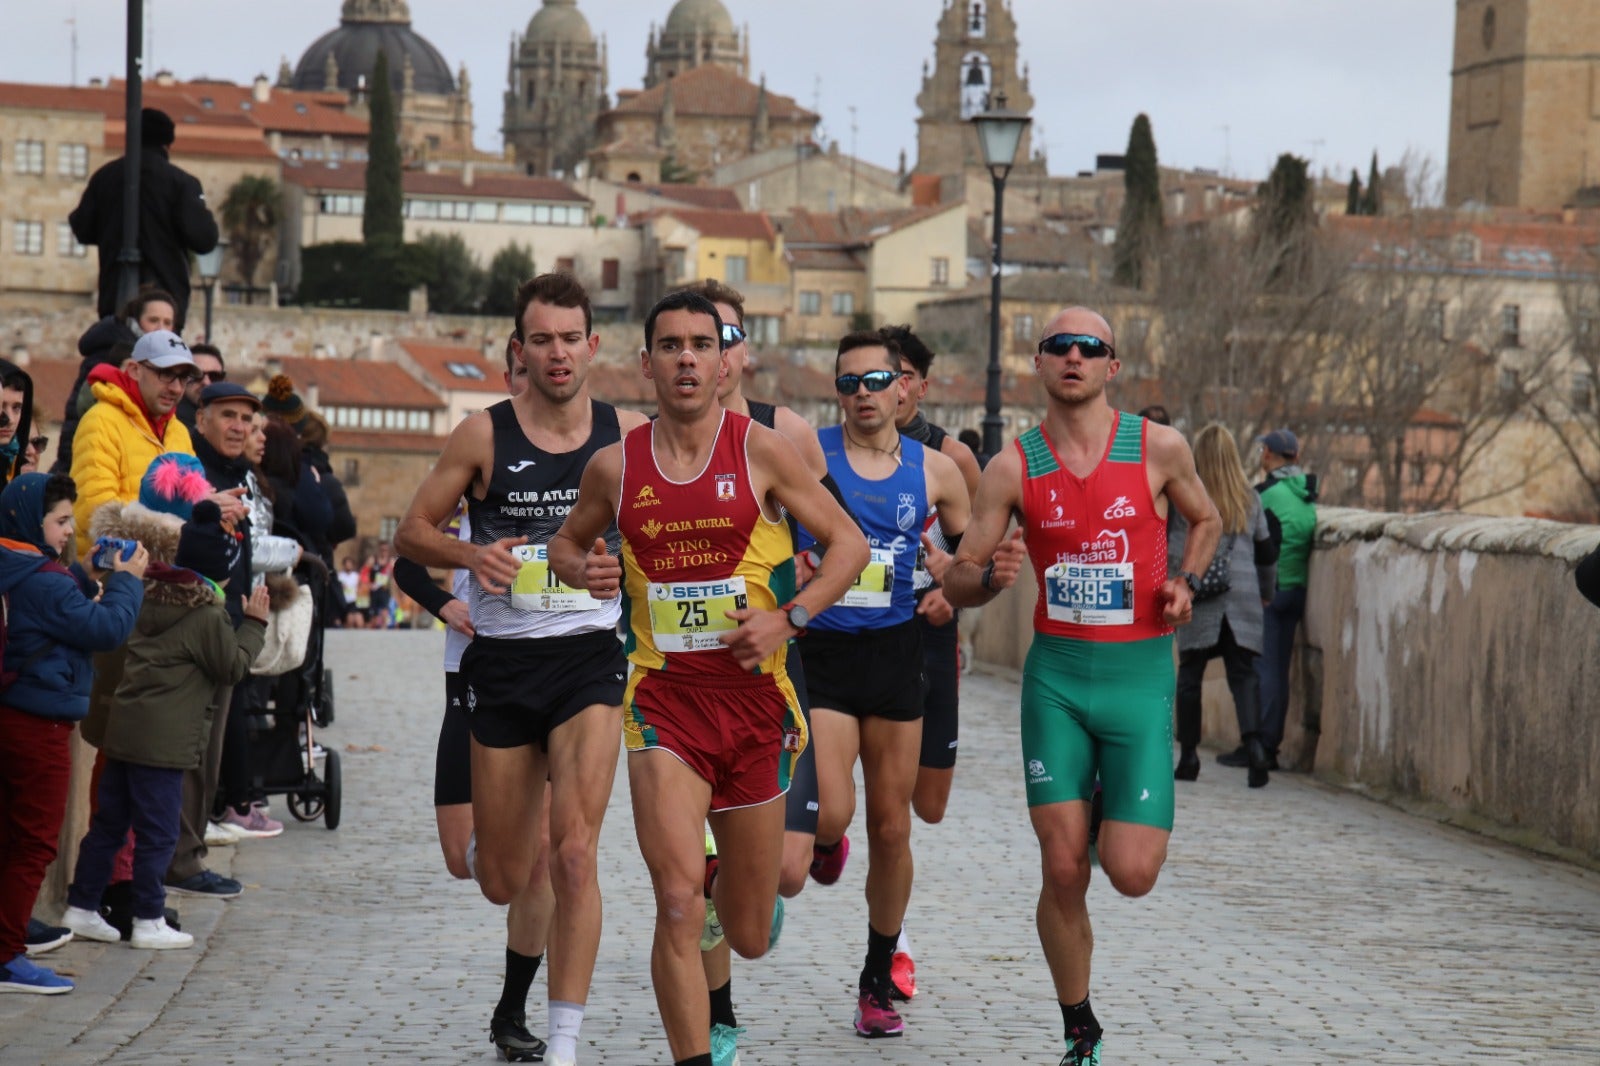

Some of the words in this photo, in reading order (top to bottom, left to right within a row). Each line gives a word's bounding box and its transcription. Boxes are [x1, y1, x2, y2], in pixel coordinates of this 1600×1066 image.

[507, 491, 538, 503] CLUB
[500, 505, 544, 517] PUERTO
[665, 520, 693, 532] CAJA
[695, 517, 733, 529] RURAL
[666, 538, 711, 554] VINO
[1081, 539, 1116, 551] Patria
[653, 556, 676, 571] DE
[679, 551, 728, 569] TORO
[1056, 549, 1117, 564] Hispana
[1068, 567, 1125, 578] SETEL
[672, 583, 736, 599] SETEL
[1056, 580, 1112, 605] 3395
[677, 600, 708, 628] 25
